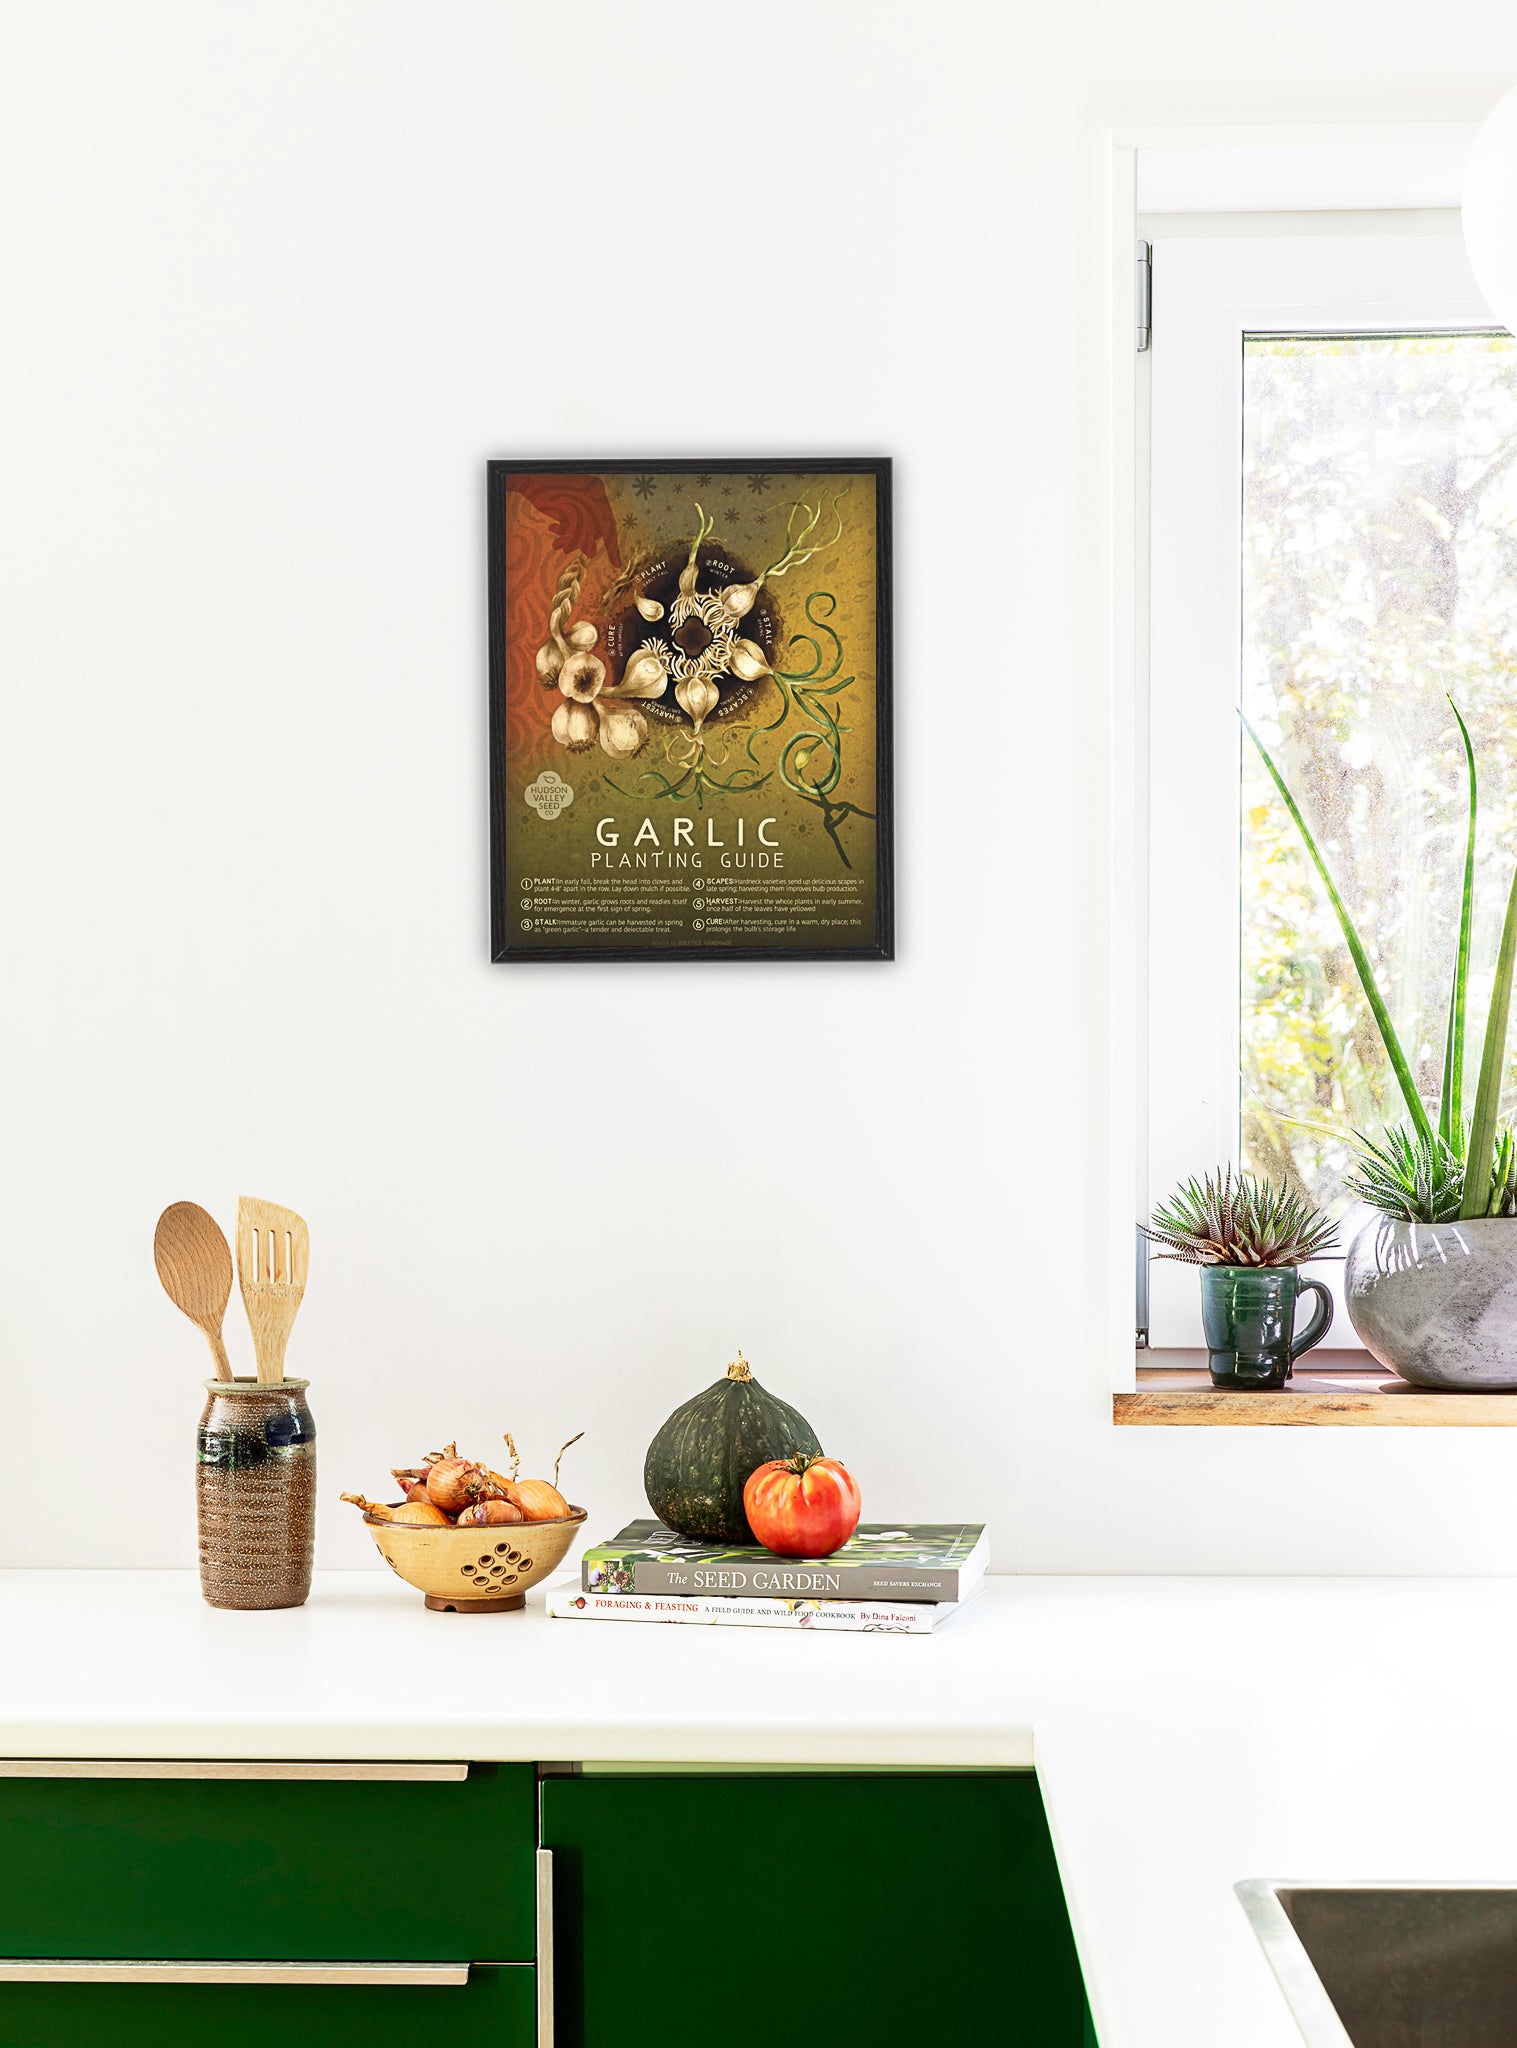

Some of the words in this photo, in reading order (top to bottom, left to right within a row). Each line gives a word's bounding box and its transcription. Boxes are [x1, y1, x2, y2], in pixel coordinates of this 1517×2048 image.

[640, 561, 666, 579] PLANT
[712, 559, 735, 574] ROOT
[763, 617, 772, 644] STALK
[641, 701, 675, 720] HARVEST
[718, 694, 748, 717] SCAPES
[530, 786, 568, 794] HUDSON
[533, 794, 565, 802] VALLEY
[538, 802, 560, 810] SEED
[596, 818, 779, 847] GARLIC
[591, 850, 702, 868] PLANTING
[720, 852, 784, 868] GUIDE
[667, 1572, 688, 1585] The
[693, 1571, 747, 1589] SEED
[752, 1572, 841, 1591] GARDEN
[595, 1599, 642, 1609] FORAGING
[644, 1601, 651, 1610] &
[655, 1602, 699, 1612] FEASTING
[711, 1606, 732, 1614] FIELD
[732, 1607, 755, 1615] GUIDE
[756, 1608, 772, 1616] AND
[773, 1609, 793, 1617] WILD
[794, 1610, 814, 1618] FOOD
[815, 1611, 856, 1620] COOKBOOK
[860, 1612, 870, 1621] By
[872, 1613, 889, 1621] Dina
[891, 1614, 916, 1622] Falconi
